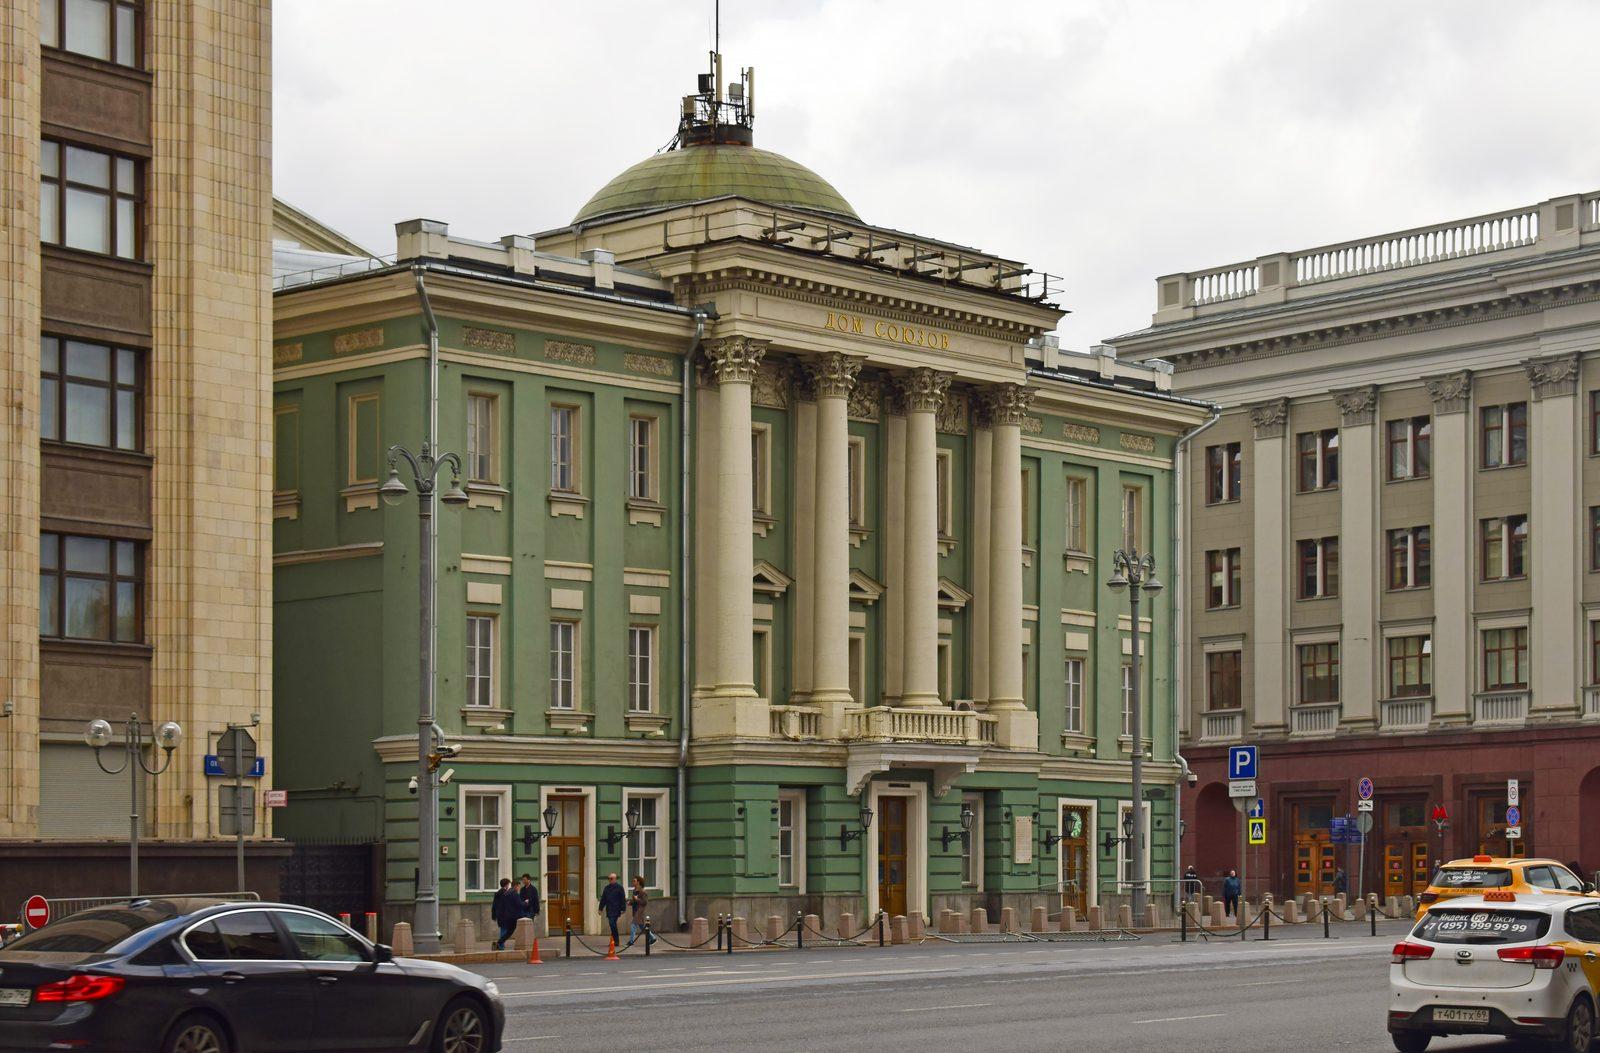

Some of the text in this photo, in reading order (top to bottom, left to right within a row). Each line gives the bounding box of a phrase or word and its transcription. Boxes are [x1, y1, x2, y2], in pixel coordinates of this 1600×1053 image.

[824, 312, 950, 350] ДОМ СОЮЗОВ
[1236, 751, 1251, 775] P
[1423, 921, 1528, 932] +7 (495) 999 99 99
[1438, 913, 1470, 921] Яндекс
[1490, 915, 1515, 923] Такси
